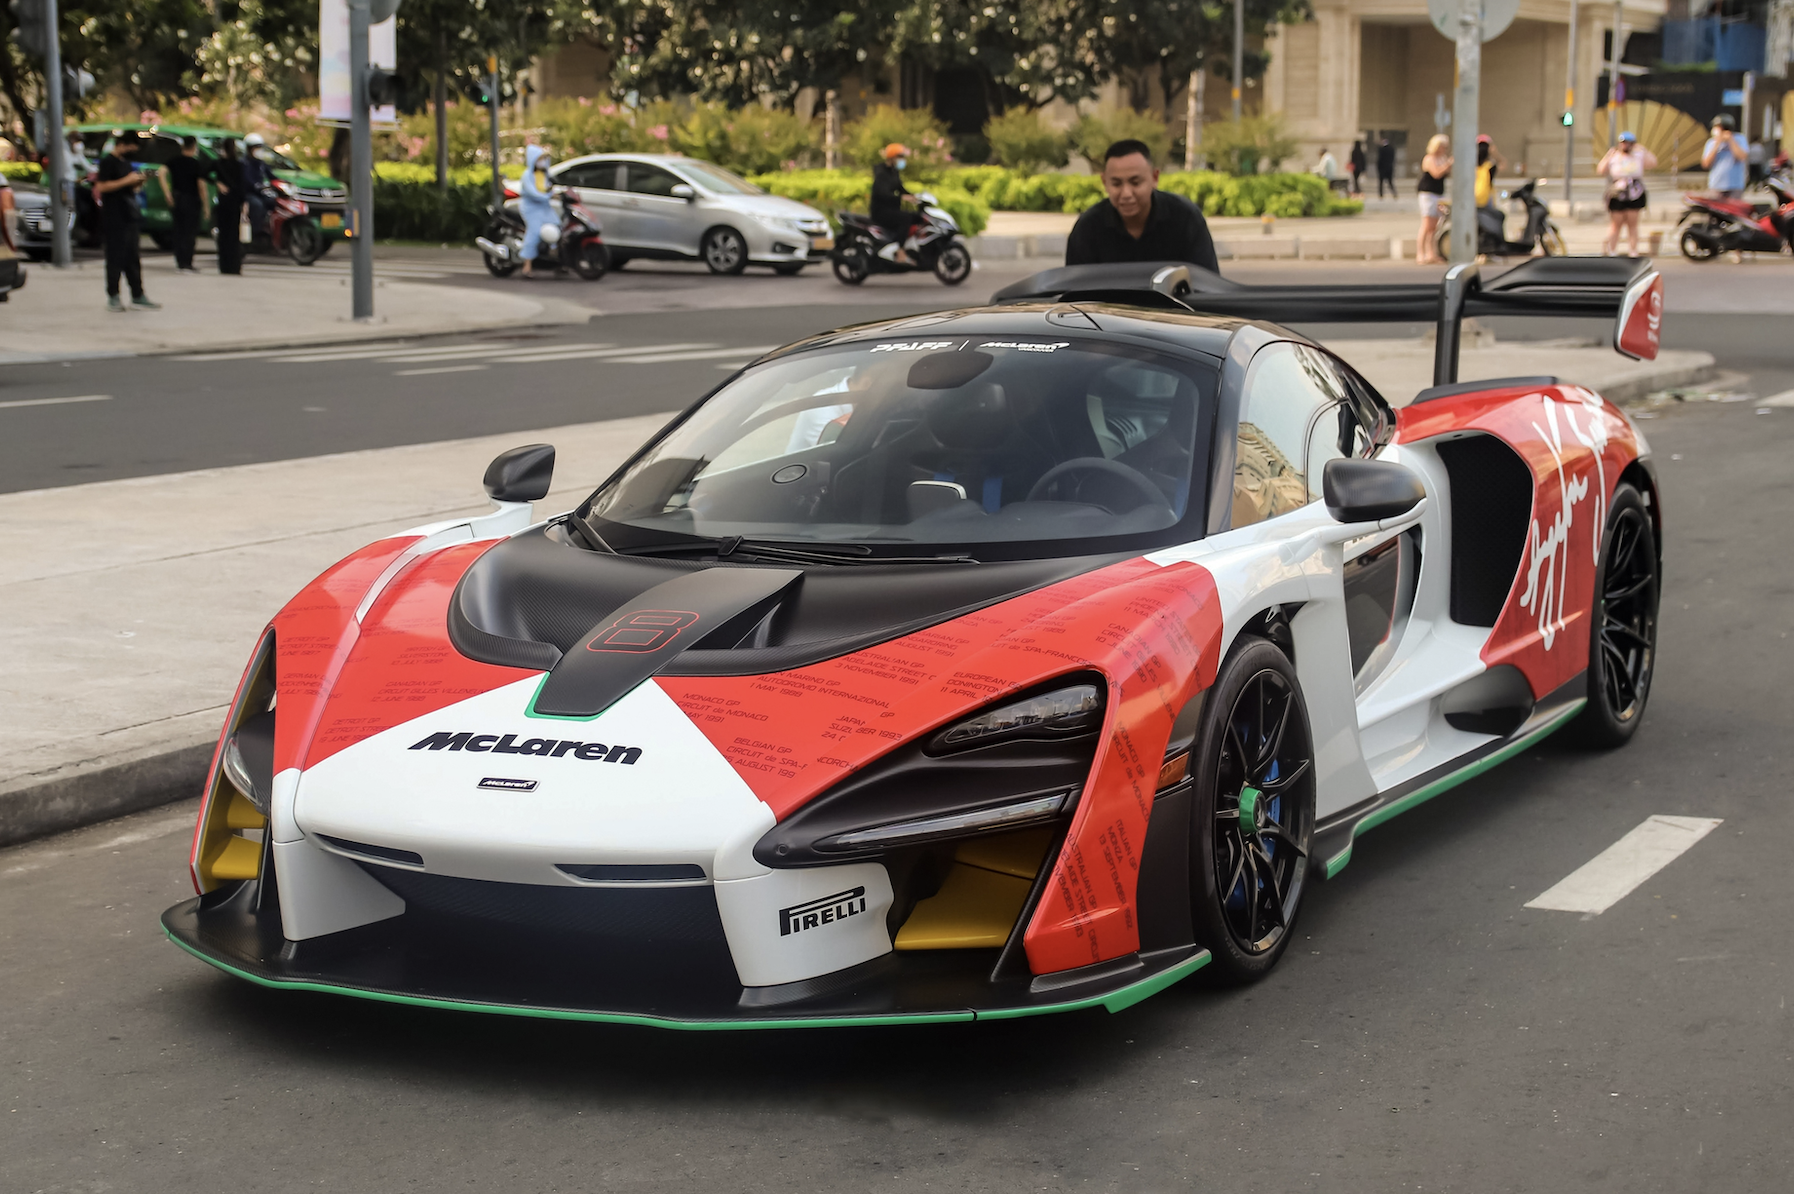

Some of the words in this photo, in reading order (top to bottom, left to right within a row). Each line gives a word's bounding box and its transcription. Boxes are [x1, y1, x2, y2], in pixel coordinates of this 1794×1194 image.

[1135, 596, 1170, 611] UNITED
[586, 609, 700, 654] 8
[842, 656, 890, 670] ADELAIDE
[889, 665, 928, 678] STREET
[910, 661, 925, 669] GP
[1151, 655, 1161, 668] GP
[786, 671, 825, 685] MARINO
[826, 679, 841, 687] GP
[844, 664, 898, 680] NOVEMBER
[899, 676, 920, 685] 1991
[953, 671, 1007, 685] EUROPEAN
[756, 683, 778, 692] MAY
[780, 688, 803, 698] 1988
[757, 675, 817, 691] AUTODROMO
[817, 687, 890, 709] INTERNAZIONAL
[950, 688, 978, 699] APRIL
[683, 693, 725, 705] MONACO
[725, 699, 741, 707] GP
[677, 700, 712, 711] CIRCUIT
[713, 706, 724, 714] de
[726, 709, 769, 722] MONACO
[705, 714, 725, 723] 1991
[332, 717, 366, 726] DETROIT
[324, 725, 359, 735] DETROIT
[407, 732, 643, 765] McLaren
[733, 737, 776, 751] BELGIAN
[777, 746, 792, 754] GP
[726, 745, 764, 759] CIRCUIT
[765, 755, 777, 763] de
[735, 758, 776, 773] AUGUST
[1135, 764, 1145, 778] GP
[482, 779, 528, 788] McLaren
[1107, 825, 1123, 864] MONZA
[1116, 819, 1132, 856] ITALIAN
[1128, 857, 1138, 871] GP
[1103, 846, 1127, 905] SEPTEMBER
[1088, 895, 1098, 909] GP
[779, 885, 866, 936] PIRELLI
